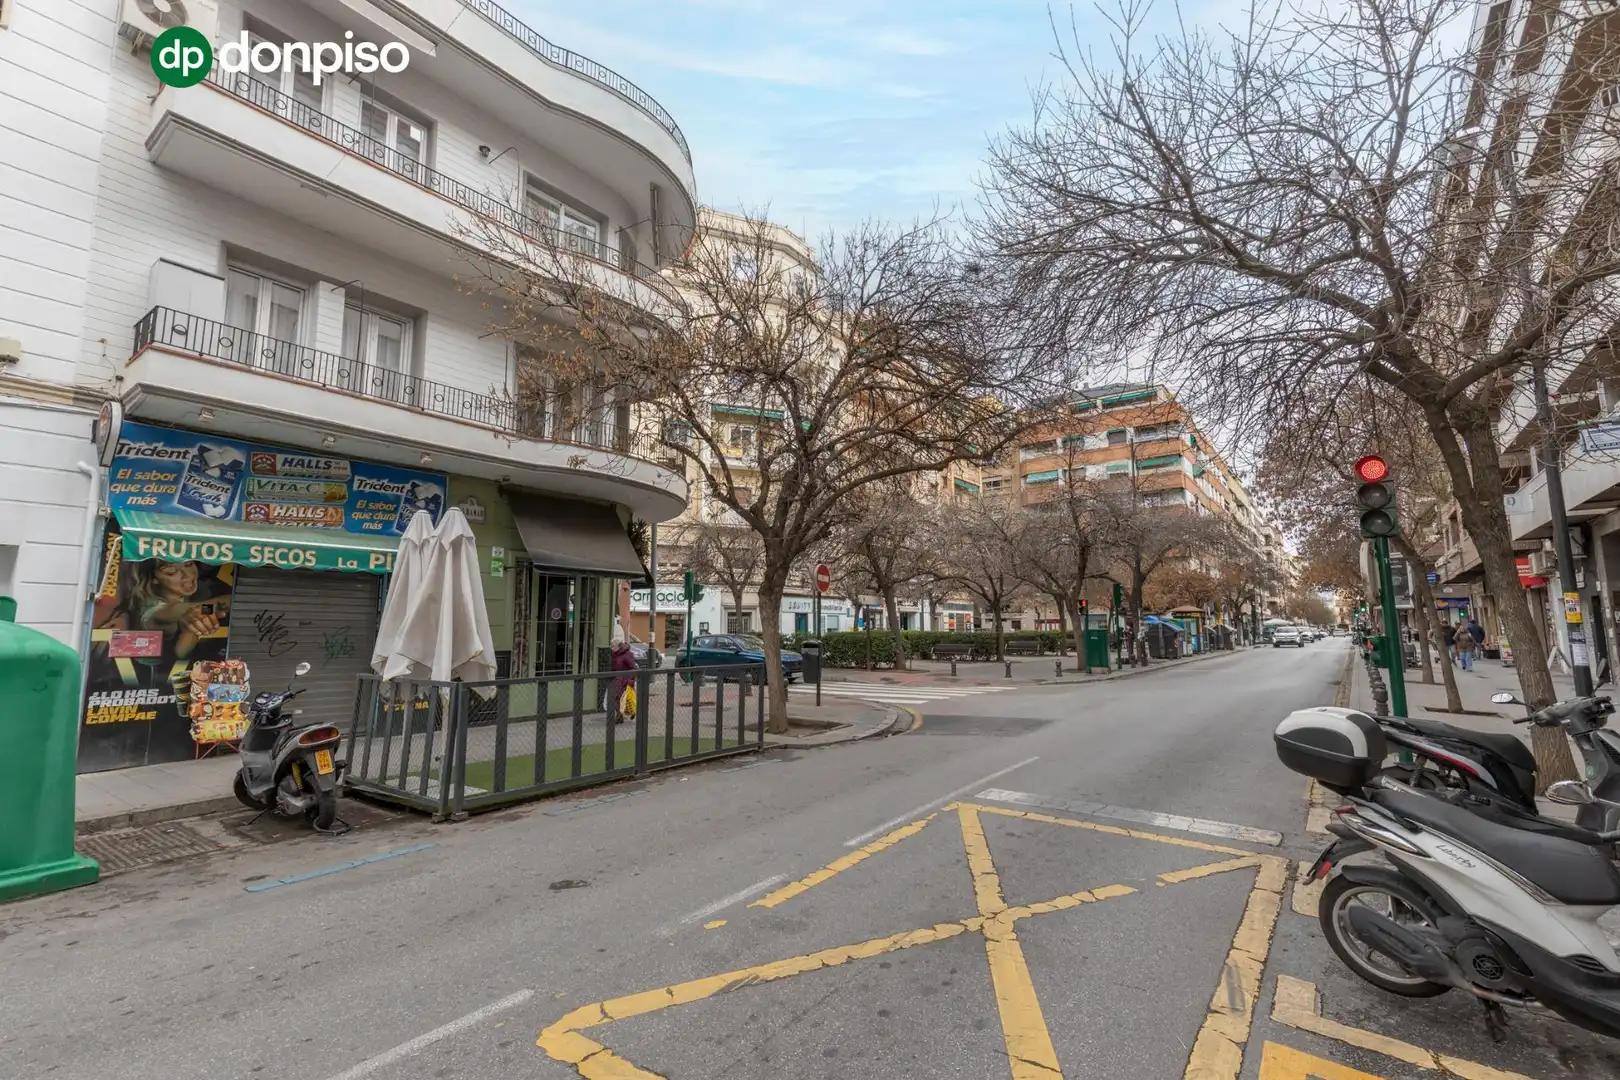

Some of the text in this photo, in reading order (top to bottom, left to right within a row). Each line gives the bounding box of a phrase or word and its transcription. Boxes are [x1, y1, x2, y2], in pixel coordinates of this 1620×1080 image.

[116, 442, 191, 460] Trident
[281, 456, 333, 470] HALLS
[116, 468, 177, 481] El sabor
[110, 482, 177, 494] que dura
[187, 474, 230, 493] Trident
[357, 479, 406, 494] Trident
[126, 494, 157, 505] más
[357, 500, 367, 509] El
[368, 500, 396, 511] sabor
[274, 505, 326, 518] HALLS
[352, 511, 371, 521] que
[372, 510, 398, 521] dura
[362, 520, 383, 530] más
[138, 536, 234, 561] FRUTOS
[249, 545, 317, 567] SECOS
[369, 552, 397, 571] PI
[124, 689, 159, 698] HAS
[88, 695, 176, 708] PROBADO?
[86, 711, 157, 724] COMPAE
